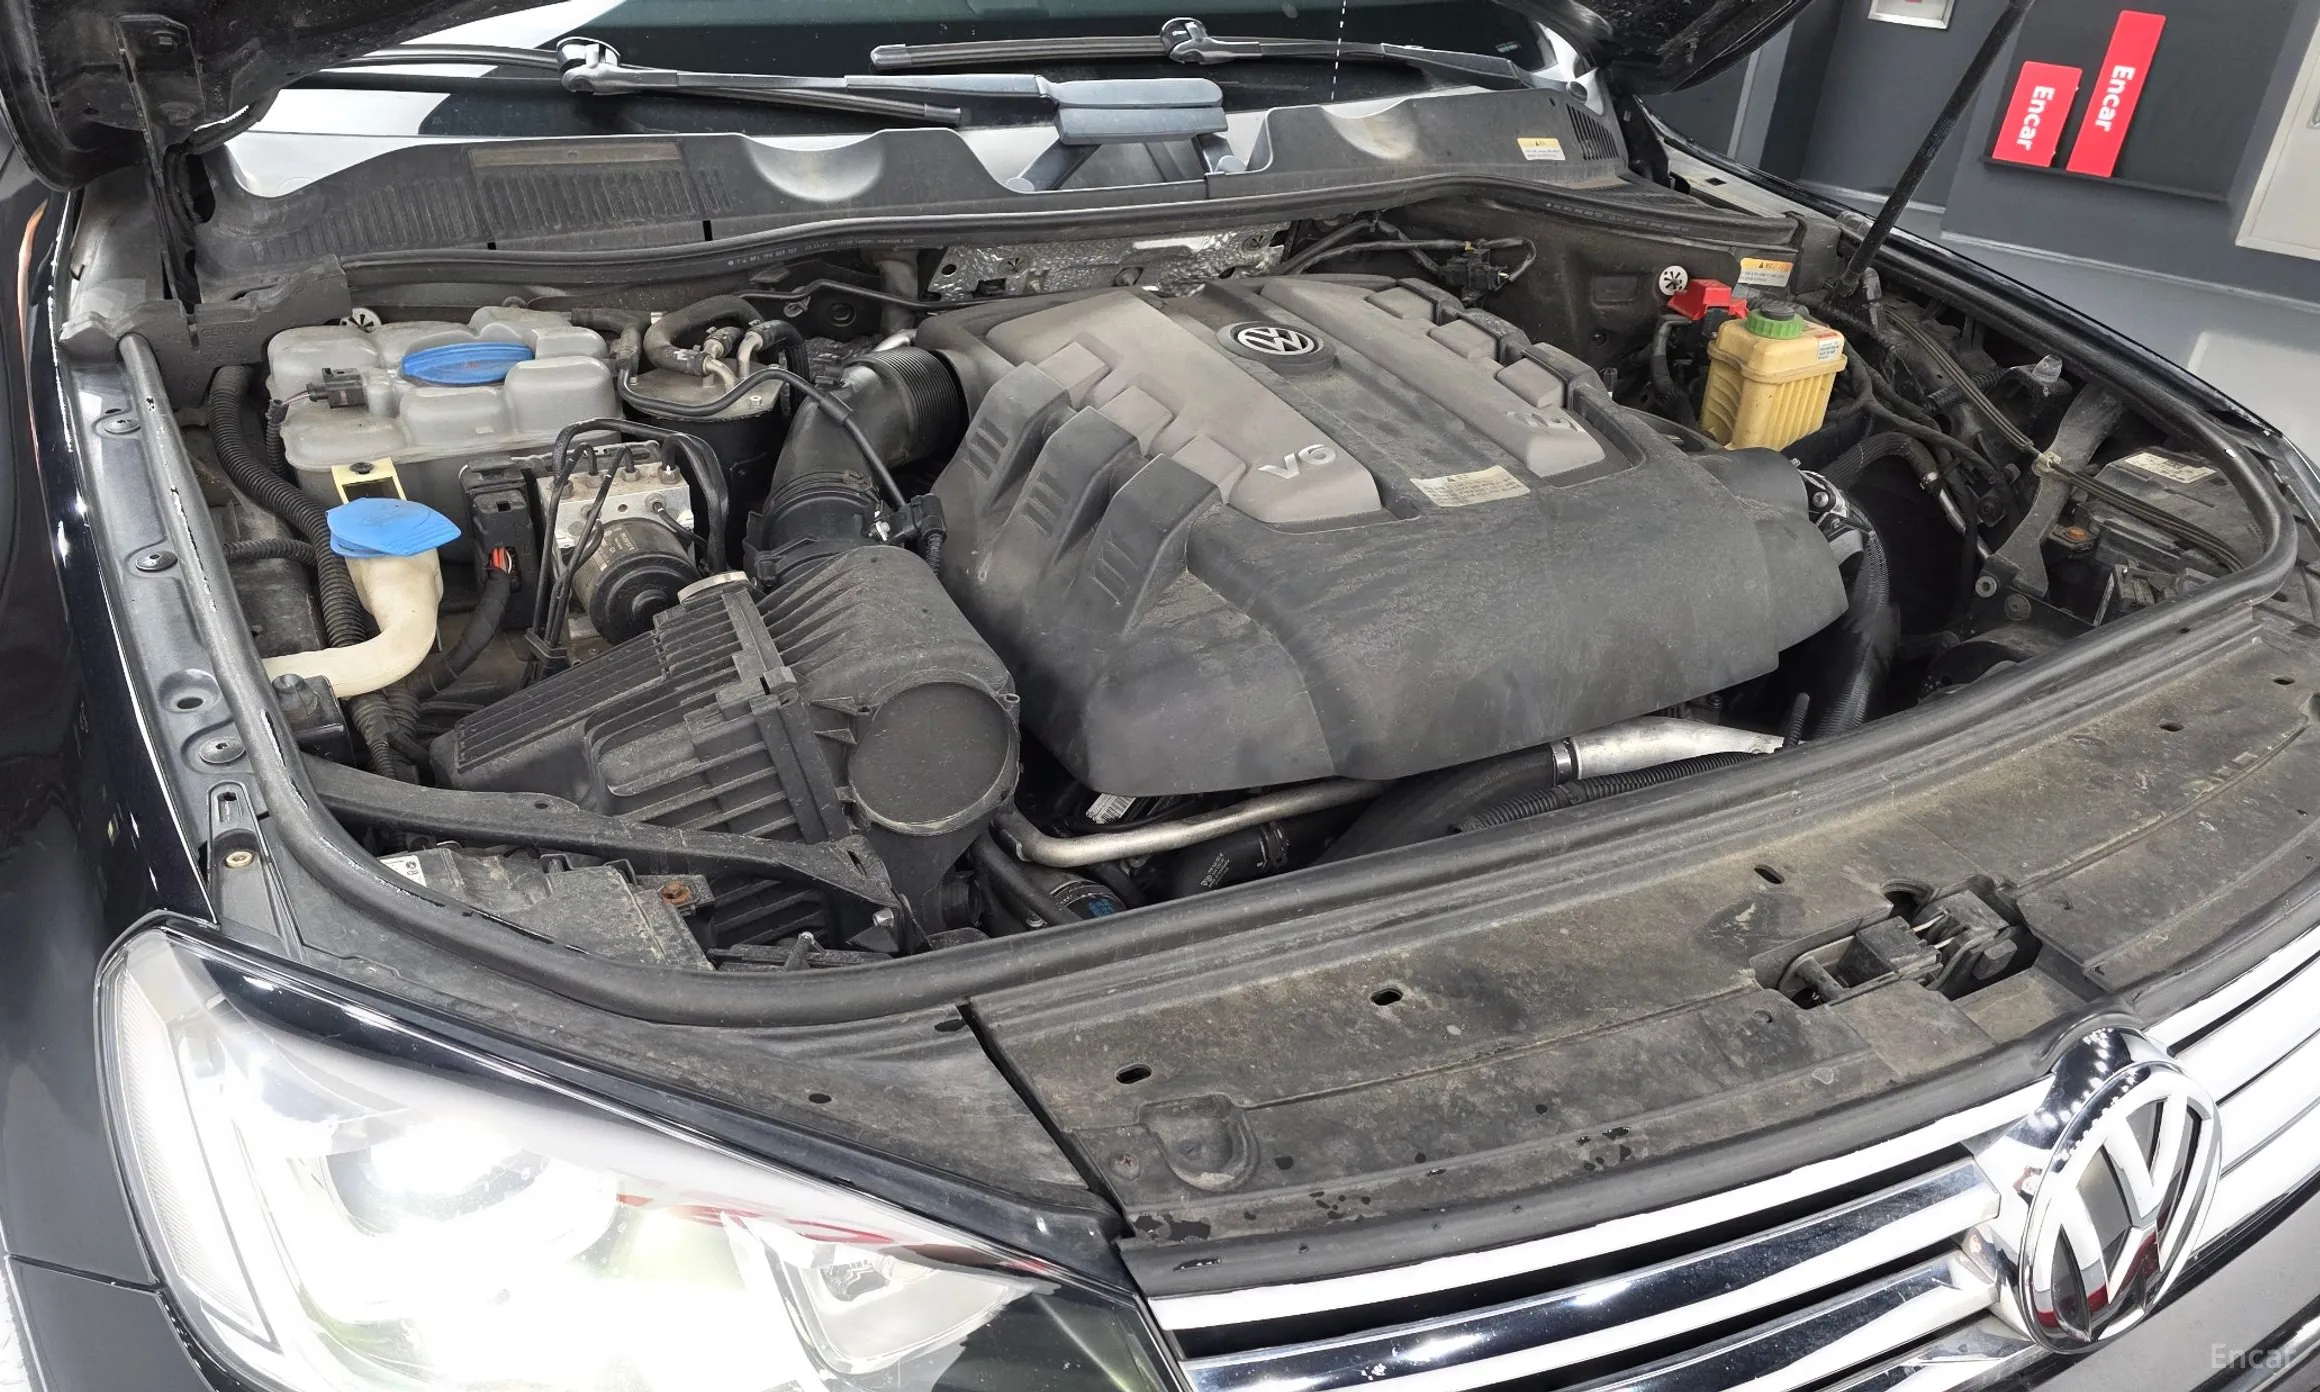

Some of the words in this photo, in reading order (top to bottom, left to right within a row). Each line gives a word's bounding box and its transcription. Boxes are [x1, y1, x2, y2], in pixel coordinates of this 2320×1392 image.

[2016, 85, 2055, 151] Encar
[2095, 65, 2136, 132] Encar
[1257, 443, 1337, 479] V6
